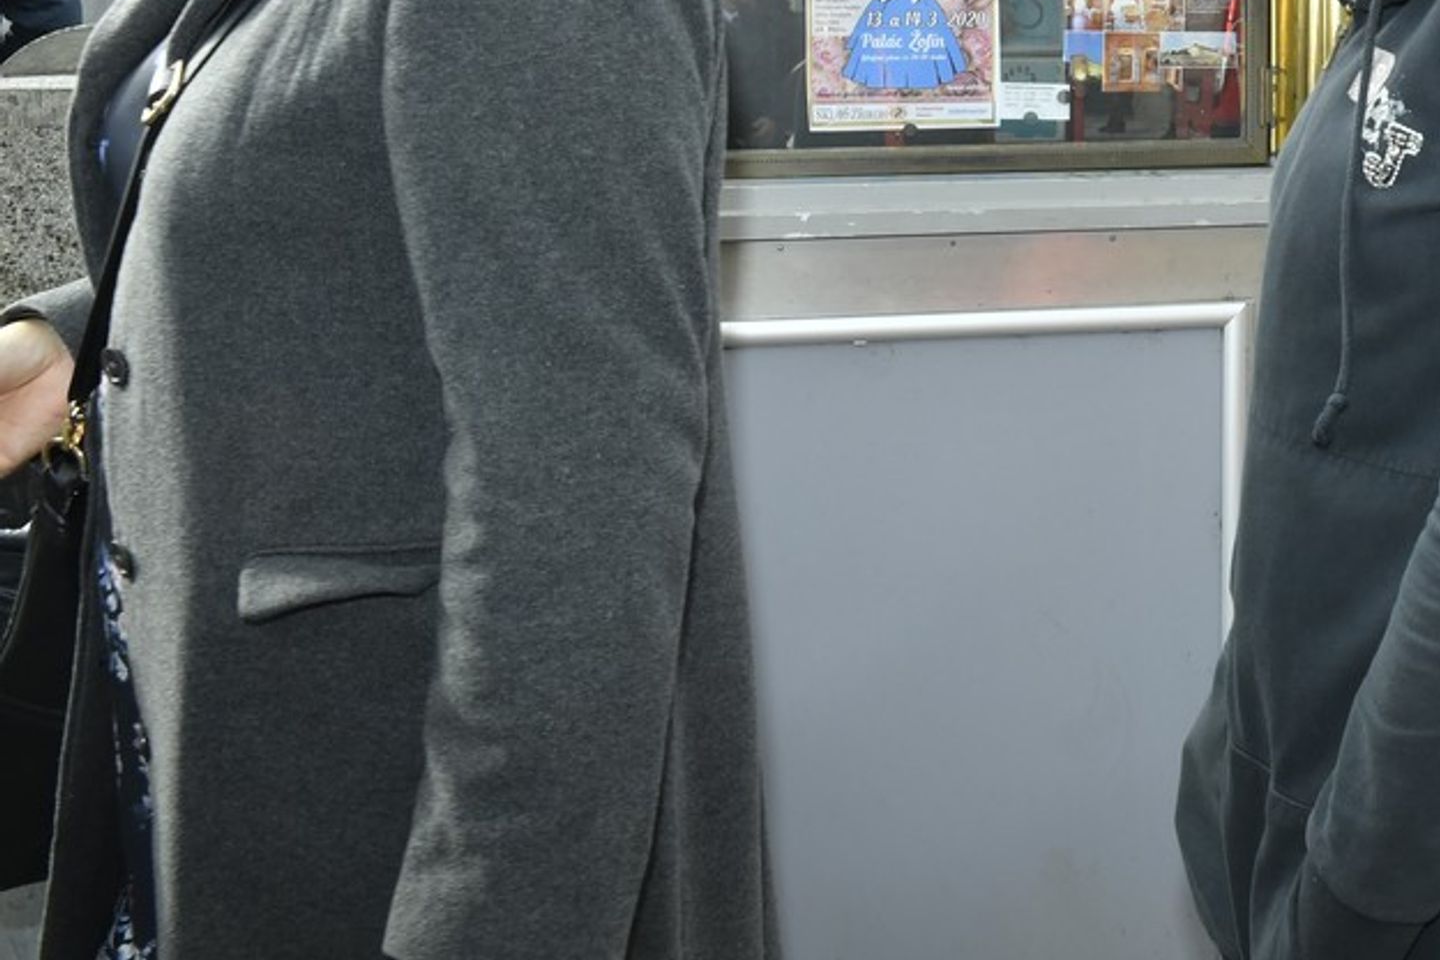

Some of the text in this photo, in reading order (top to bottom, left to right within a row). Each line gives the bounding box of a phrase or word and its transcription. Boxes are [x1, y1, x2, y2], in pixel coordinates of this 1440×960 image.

[889, 16, 901, 28] a
[946, 10, 987, 28] 2020
[860, 32, 903, 49] Palác
